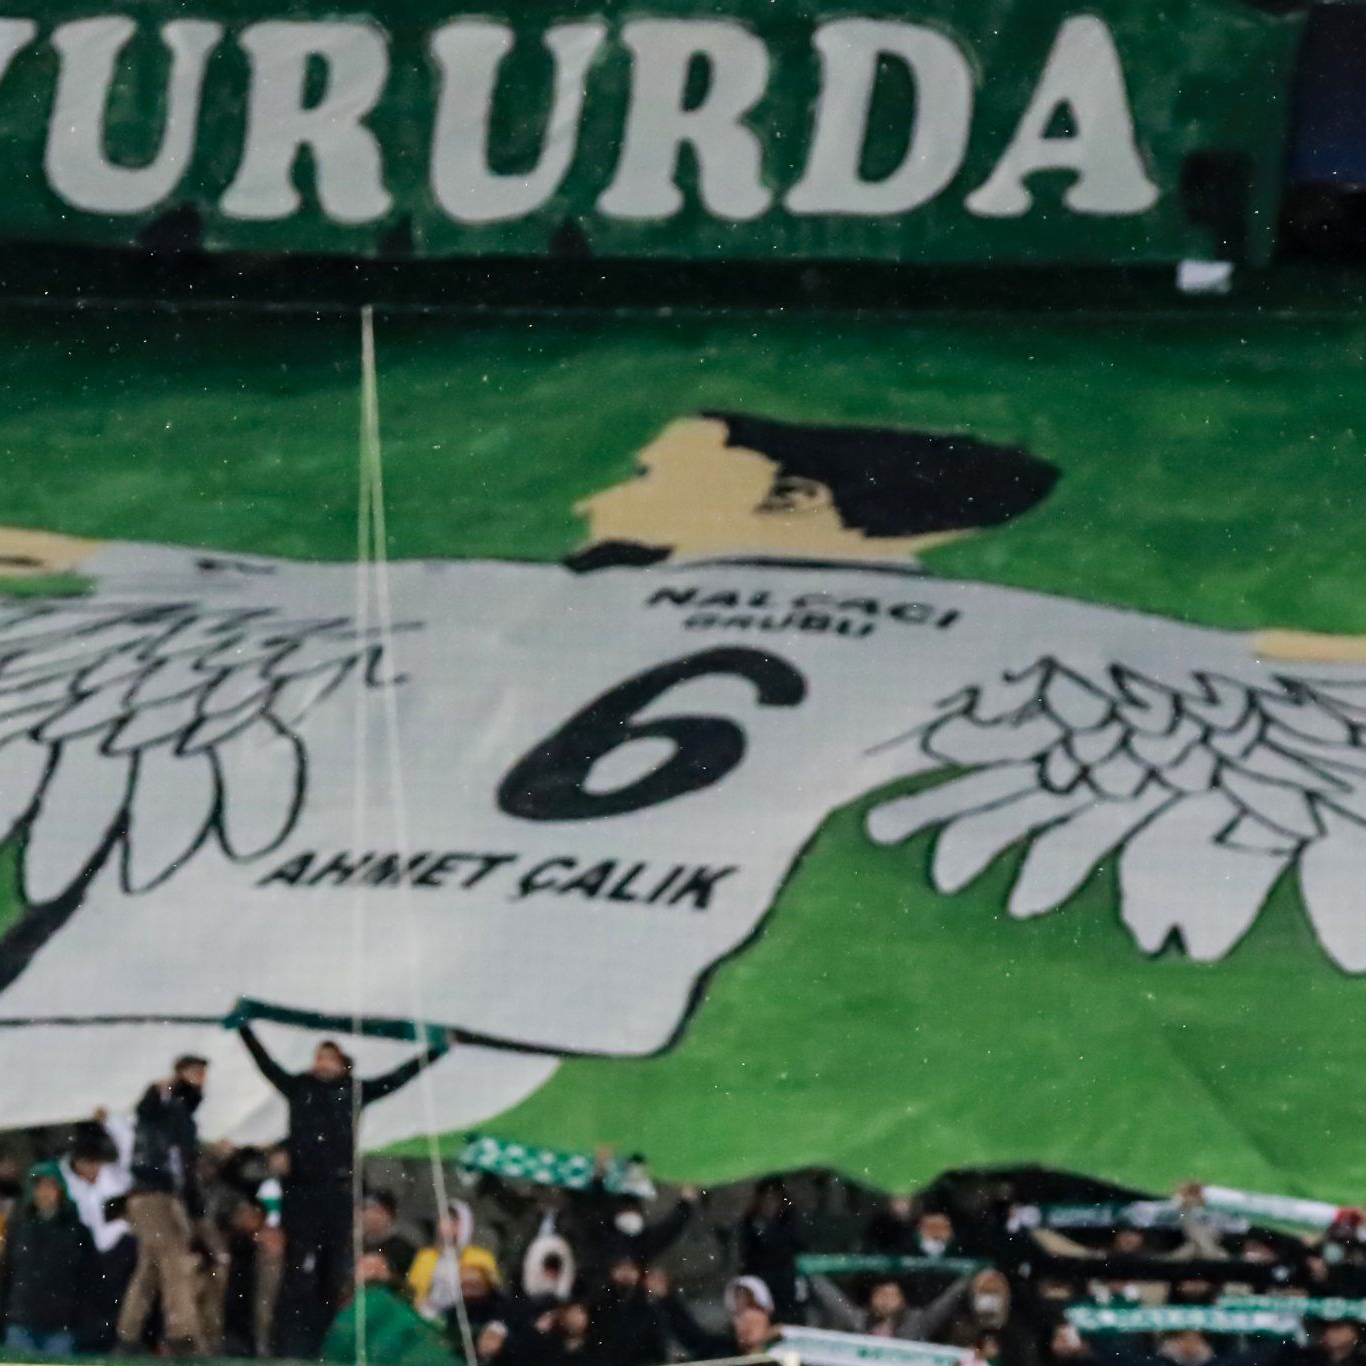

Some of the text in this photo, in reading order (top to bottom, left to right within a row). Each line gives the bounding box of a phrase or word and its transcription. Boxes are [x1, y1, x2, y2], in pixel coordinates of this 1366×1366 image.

[496, 645, 808, 821] 6
[256, 850, 740, 912] AHMET ÇALIK
